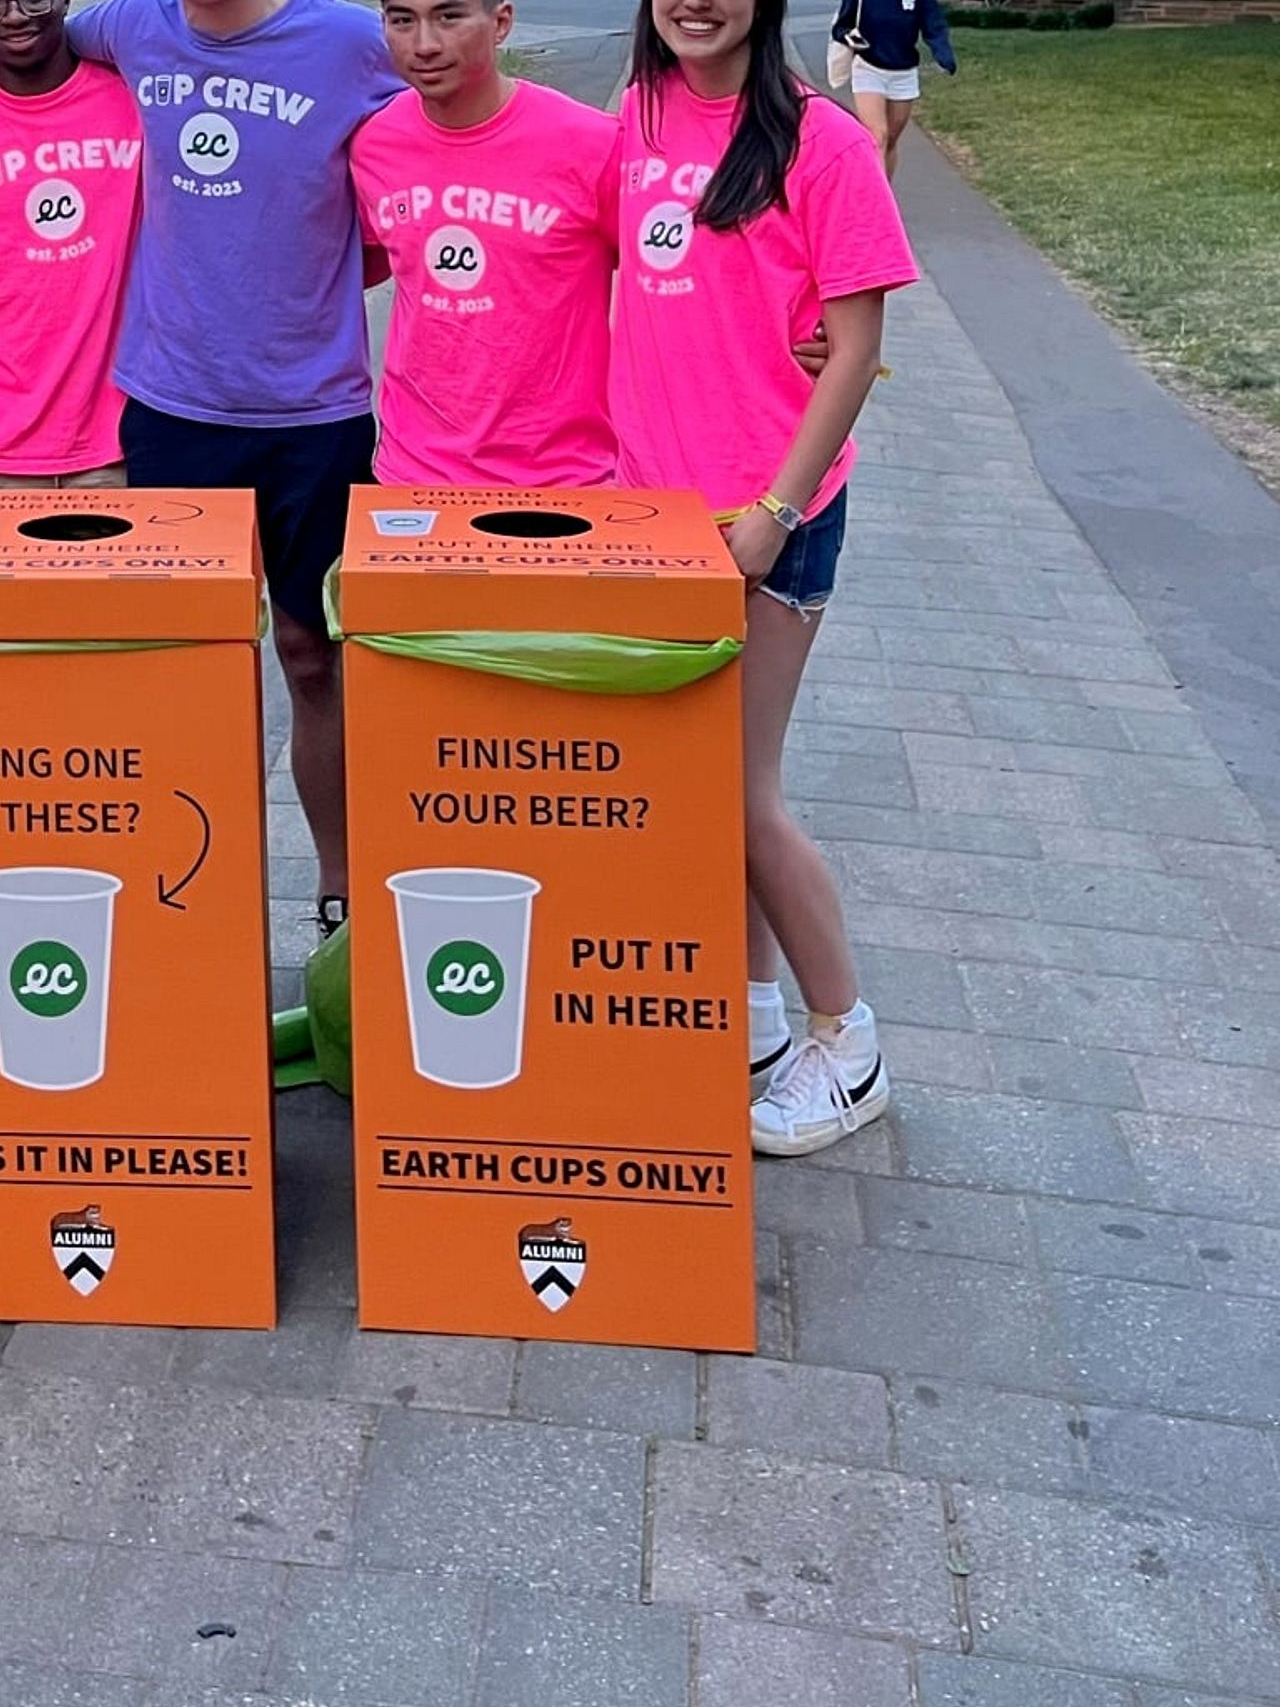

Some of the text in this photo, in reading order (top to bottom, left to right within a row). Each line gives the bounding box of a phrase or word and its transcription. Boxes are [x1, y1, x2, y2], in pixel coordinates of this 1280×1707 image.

[203, 76, 315, 126] CREW
[34, 138, 141, 174] CREW
[186, 132, 230, 158] ec
[202, 180, 242, 197] 2023
[35, 195, 77, 224] ec
[442, 184, 562, 236] CREW
[59, 236, 96, 261] 2023
[644, 221, 683, 250] ec
[435, 246, 478, 272] ec
[456, 295, 494, 313] 2023
[24, 558, 115, 570] CUPS
[124, 557, 228, 570] ONLY!
[368, 553, 709, 569] EARTH CUPS ONLY!
[64, 747, 143, 779] ONE
[437, 738, 621, 772] FINISHED
[0, 802, 141, 834] THESE?
[409, 792, 650, 830] YOUR BEER?
[572, 938, 701, 973] PUT IT
[18, 962, 79, 996] ec
[435, 962, 497, 996] ec
[554, 993, 730, 1031] IN HERE!
[16, 1144, 49, 1173] IT
[57, 1146, 94, 1174] IN
[104, 1148, 248, 1177] PLEASE!
[382, 1148, 728, 1195] EARTH CUPS ONLY!
[53, 1230, 113, 1248] ALUMNI
[521, 1244, 584, 1261] ALUMNI
